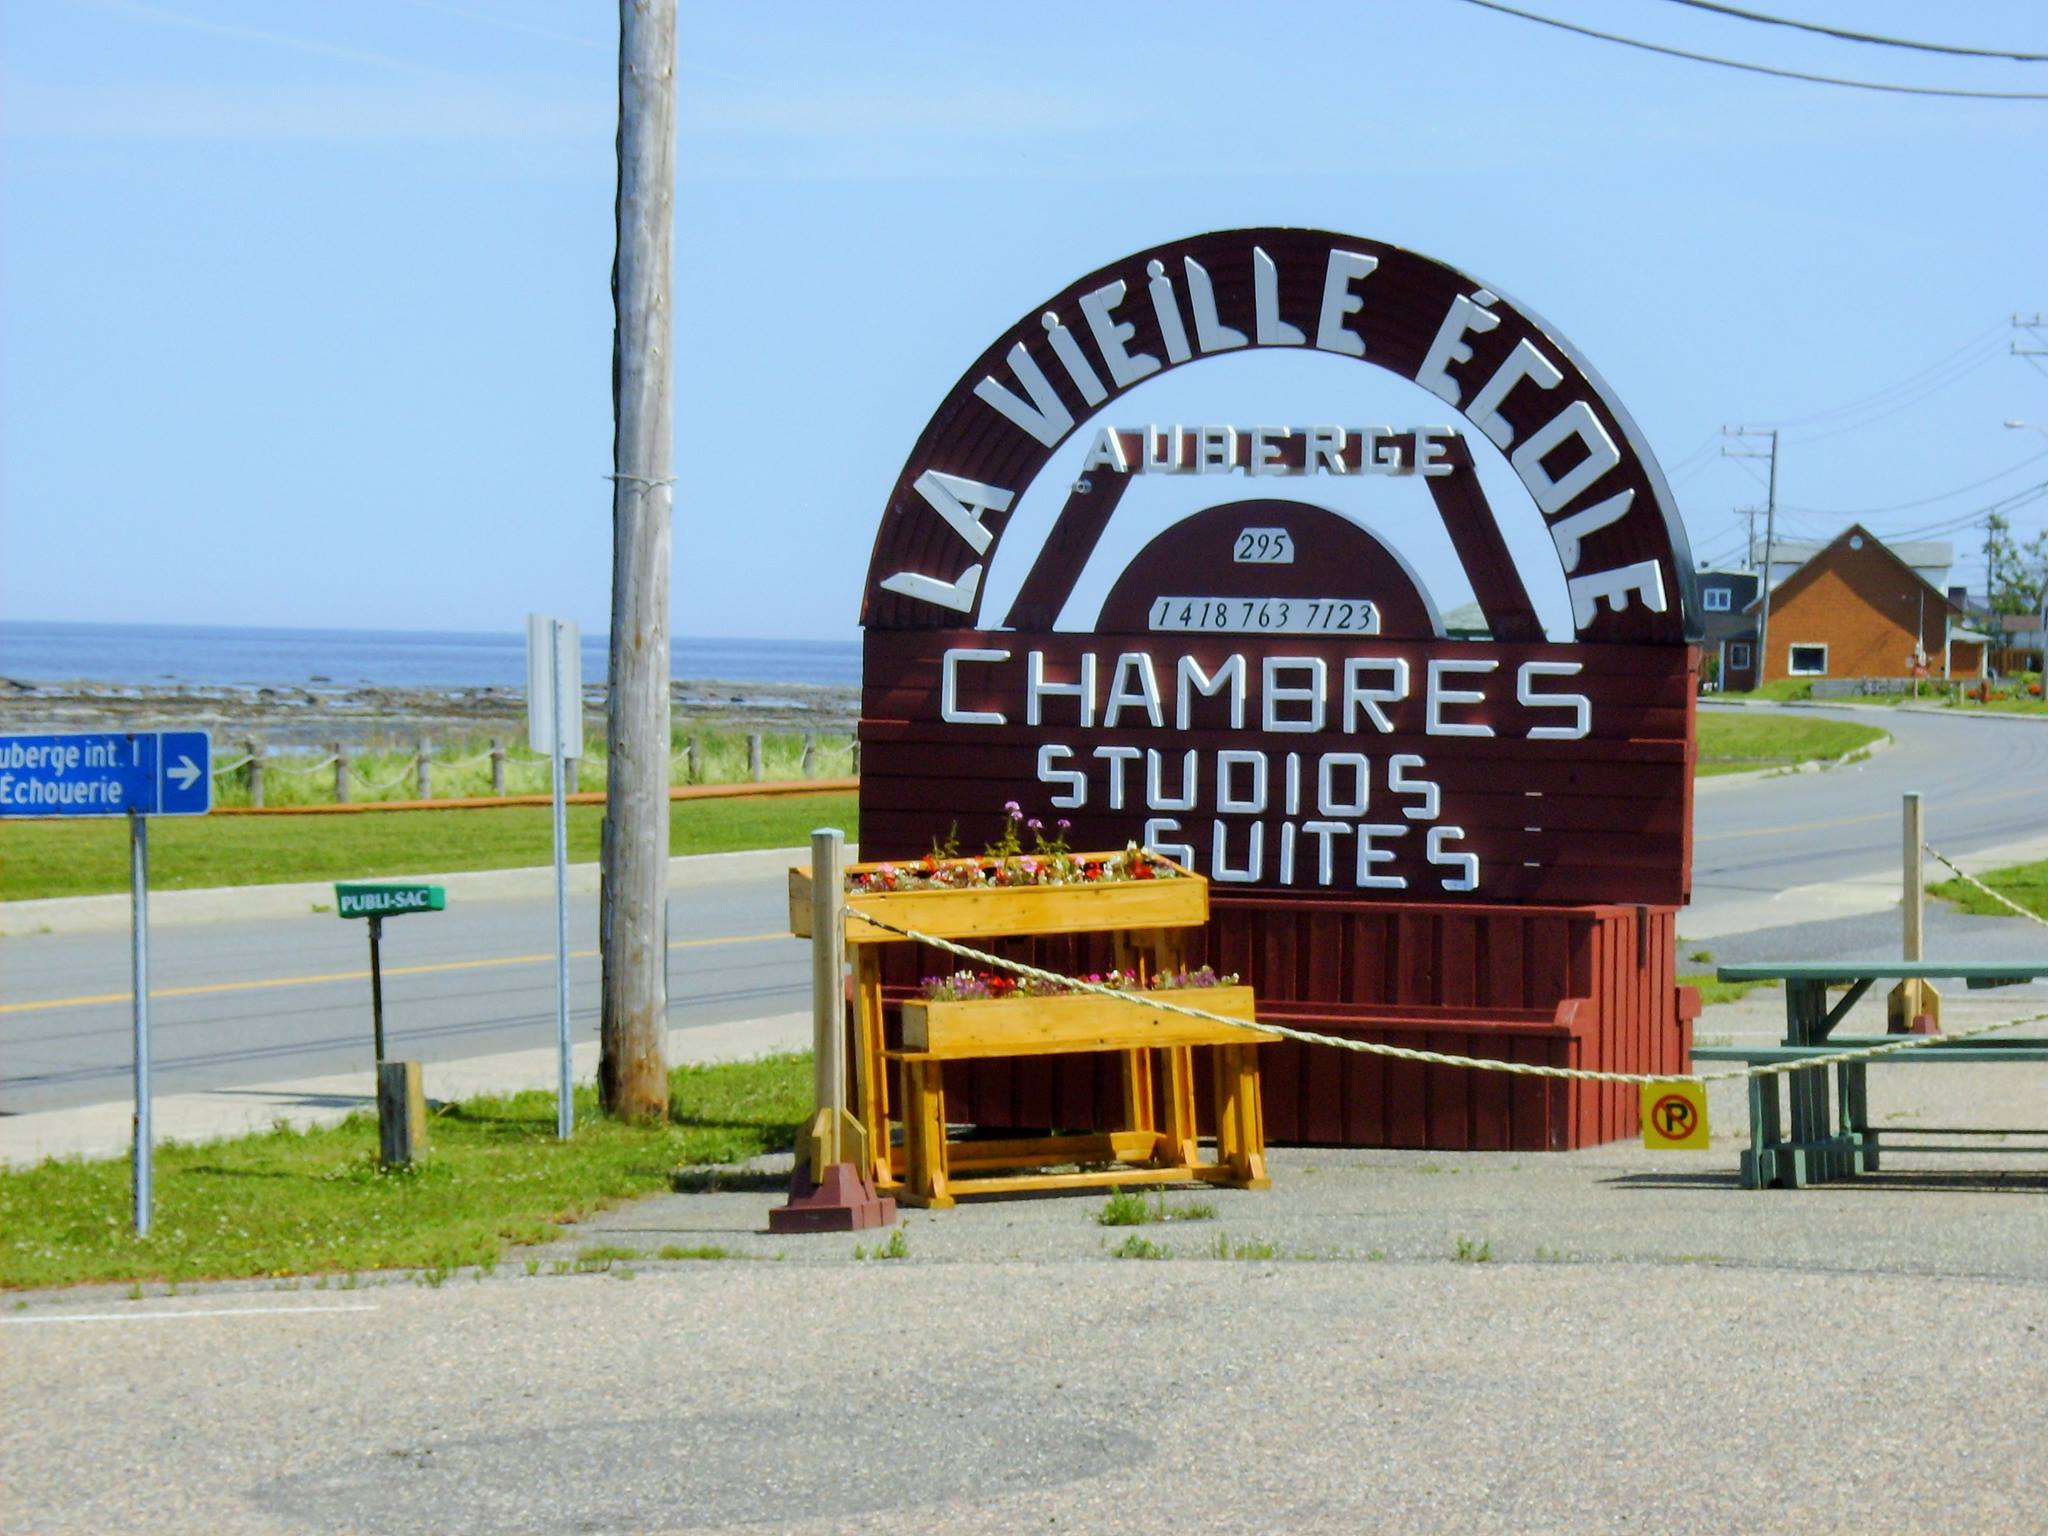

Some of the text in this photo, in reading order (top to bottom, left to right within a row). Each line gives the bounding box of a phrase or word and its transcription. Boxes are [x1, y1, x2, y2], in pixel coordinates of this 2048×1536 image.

[1083, 424, 1456, 476] AUBERGE
[880, 470, 1015, 612] LA
[1239, 534, 1286, 560] 295
[1158, 602, 1171, 627] 1
[1242, 603, 1290, 629] 763
[1307, 604, 1371, 631] 7123
[941, 648, 1593, 740] CHAMBRES
[85, 740, 124, 767] int.
[1037, 744, 1441, 820] STUDIOS
[1144, 818, 1480, 892] SUITES
[341, 890, 428, 911] PUBLI-SAC
